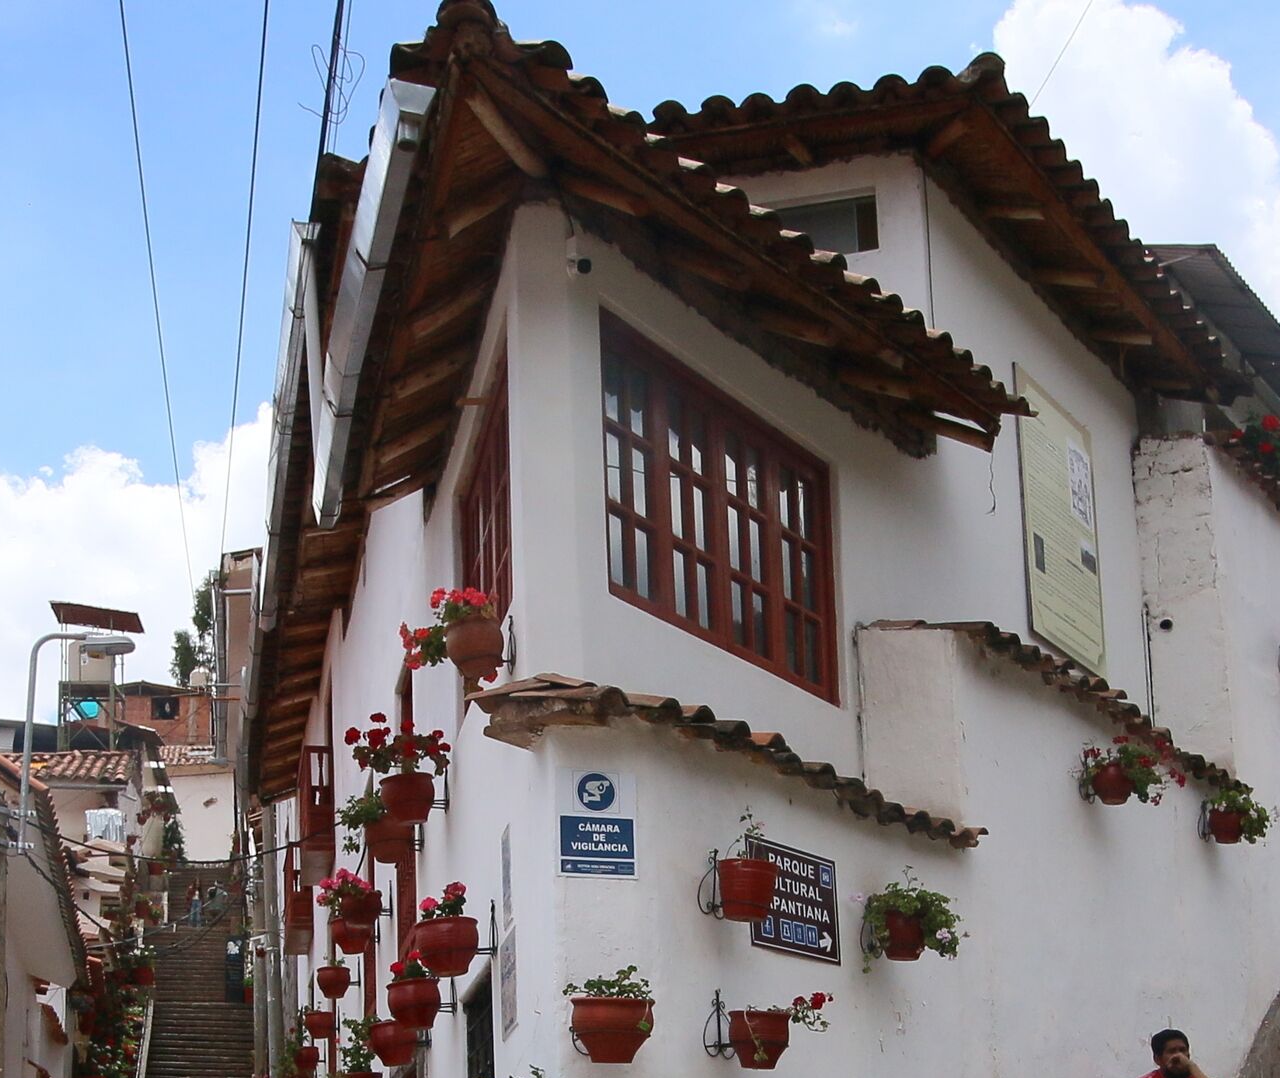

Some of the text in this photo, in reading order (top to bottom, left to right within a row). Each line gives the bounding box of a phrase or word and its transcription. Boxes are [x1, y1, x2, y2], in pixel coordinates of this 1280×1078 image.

[578, 821, 620, 833] CÁMARA
[570, 841, 629, 852] VIGILANCIA
[592, 833, 606, 842] DE
[768, 852, 815, 880] PARQUE
[774, 875, 823, 902] LTURAL
[770, 895, 830, 924] PANTIANA
